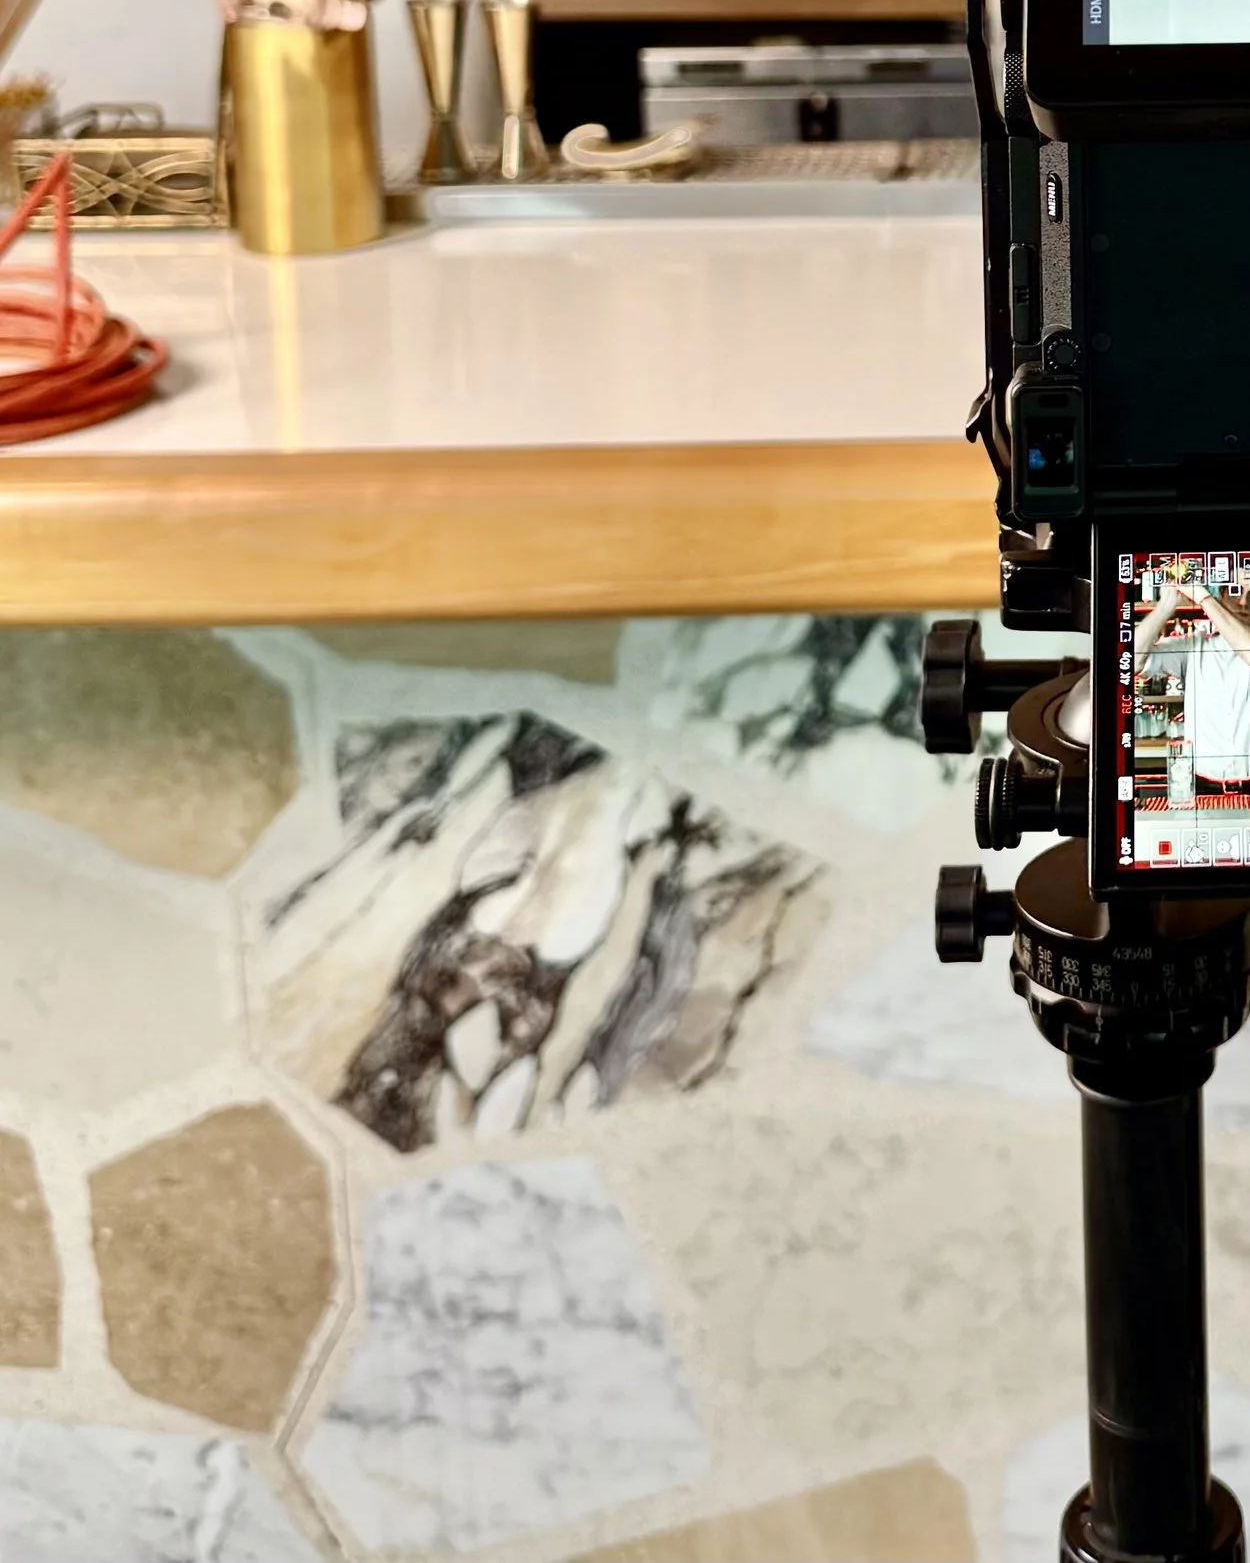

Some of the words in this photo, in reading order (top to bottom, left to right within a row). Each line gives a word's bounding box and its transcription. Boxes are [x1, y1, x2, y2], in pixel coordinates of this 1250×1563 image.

[1047, 181, 1057, 217] MENU
[1119, 602, 1131, 620] min
[1119, 651, 1133, 671] 60p
[1119, 672, 1131, 686] 4K
[1121, 694, 1133, 715] REC
